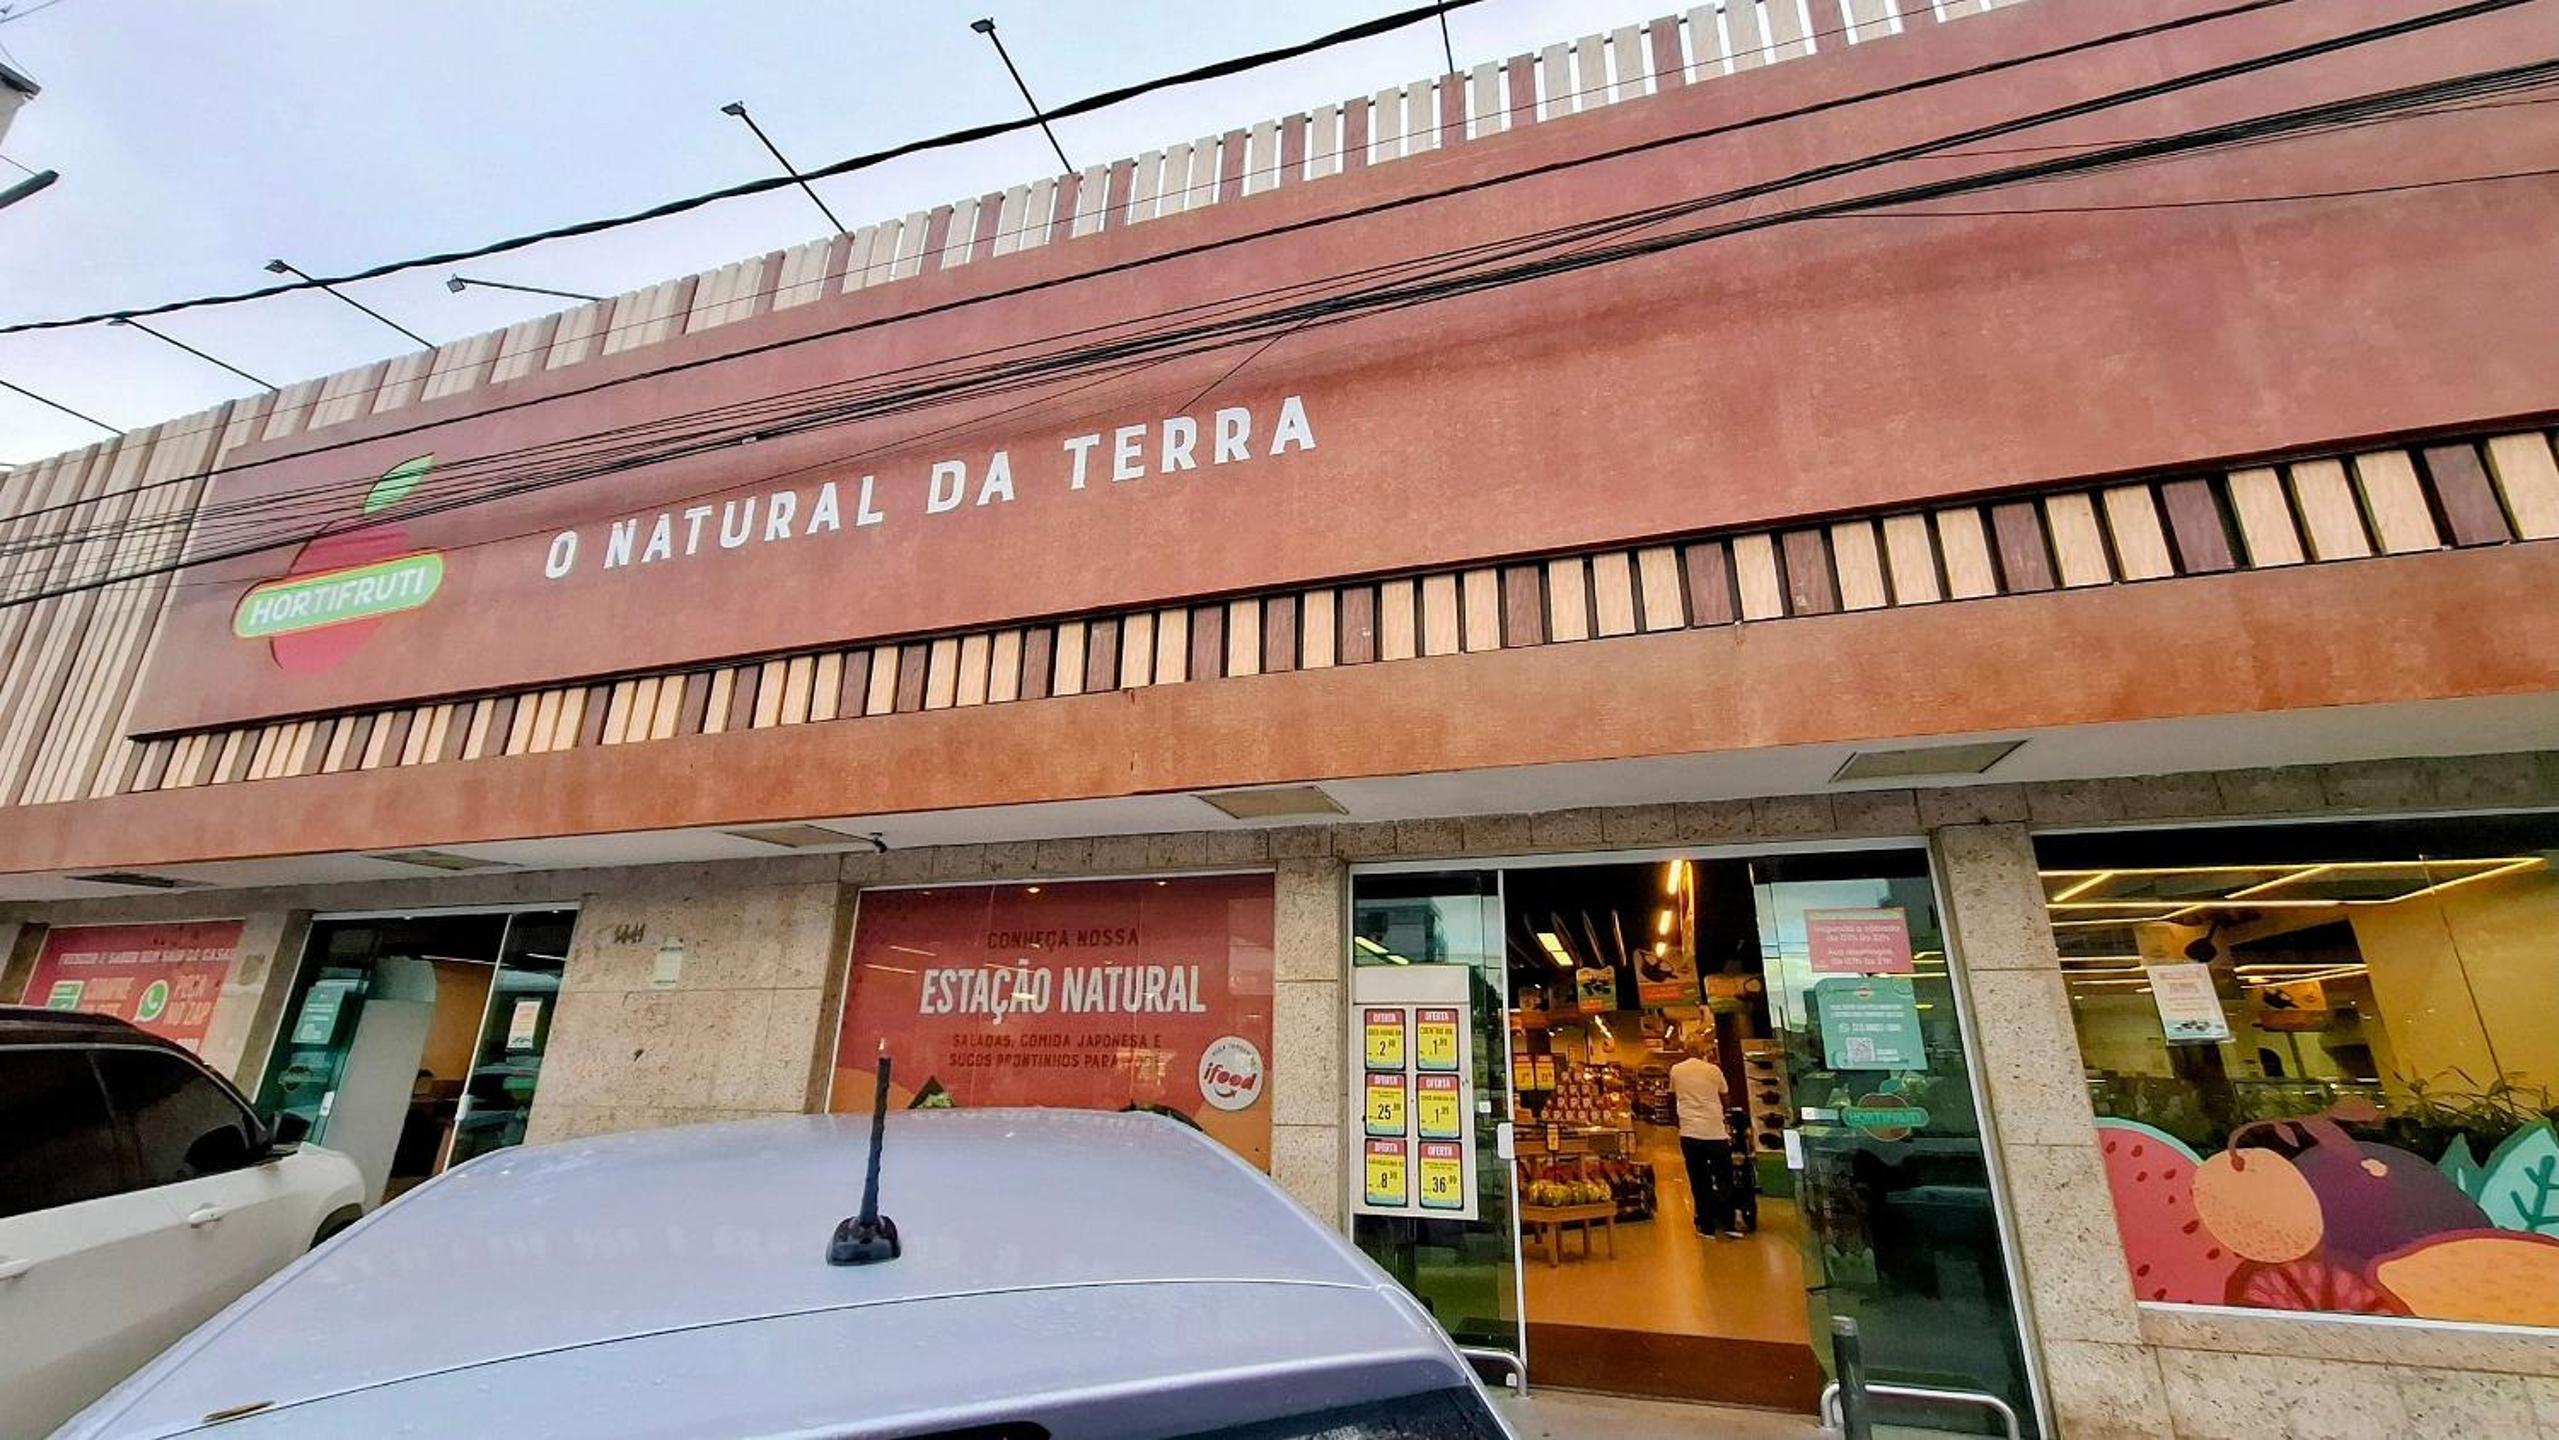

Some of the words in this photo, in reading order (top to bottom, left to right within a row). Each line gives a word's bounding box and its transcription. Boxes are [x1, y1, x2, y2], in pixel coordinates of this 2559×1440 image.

[544, 530, 579, 580] O
[602, 475, 885, 569] NATURAL
[924, 451, 1016, 514] DA
[1062, 395, 1317, 490] TERRA
[249, 565, 427, 627] HORTIFRUTI
[988, 929, 1069, 953] CONHEÇA
[1077, 927, 1139, 947] NOSSA
[919, 958, 1052, 1025] ESTAÇÃO
[1060, 965, 1208, 1014] NATURAL
[1373, 1013, 1396, 1023] OFERTA
[1424, 1011, 1449, 1021] OFERTA
[1020, 1034, 1071, 1048] COMIDA
[1077, 1034, 1148, 1048] JAPONESA
[1153, 1034, 1161, 1048] E
[949, 1053, 992, 1067] SUCOS
[995, 1053, 1079, 1067] PRONTINHOS
[1084, 1053, 1118, 1067] PARA
[1374, 1075, 1398, 1085] OFERTA
[1425, 1077, 1451, 1089] OFERTA
[1378, 1103, 1391, 1120] 25
[1374, 1142, 1398, 1153] OFERTA
[1427, 1146, 1453, 1156] OFERTA
[1432, 1176, 1446, 1193] 36
